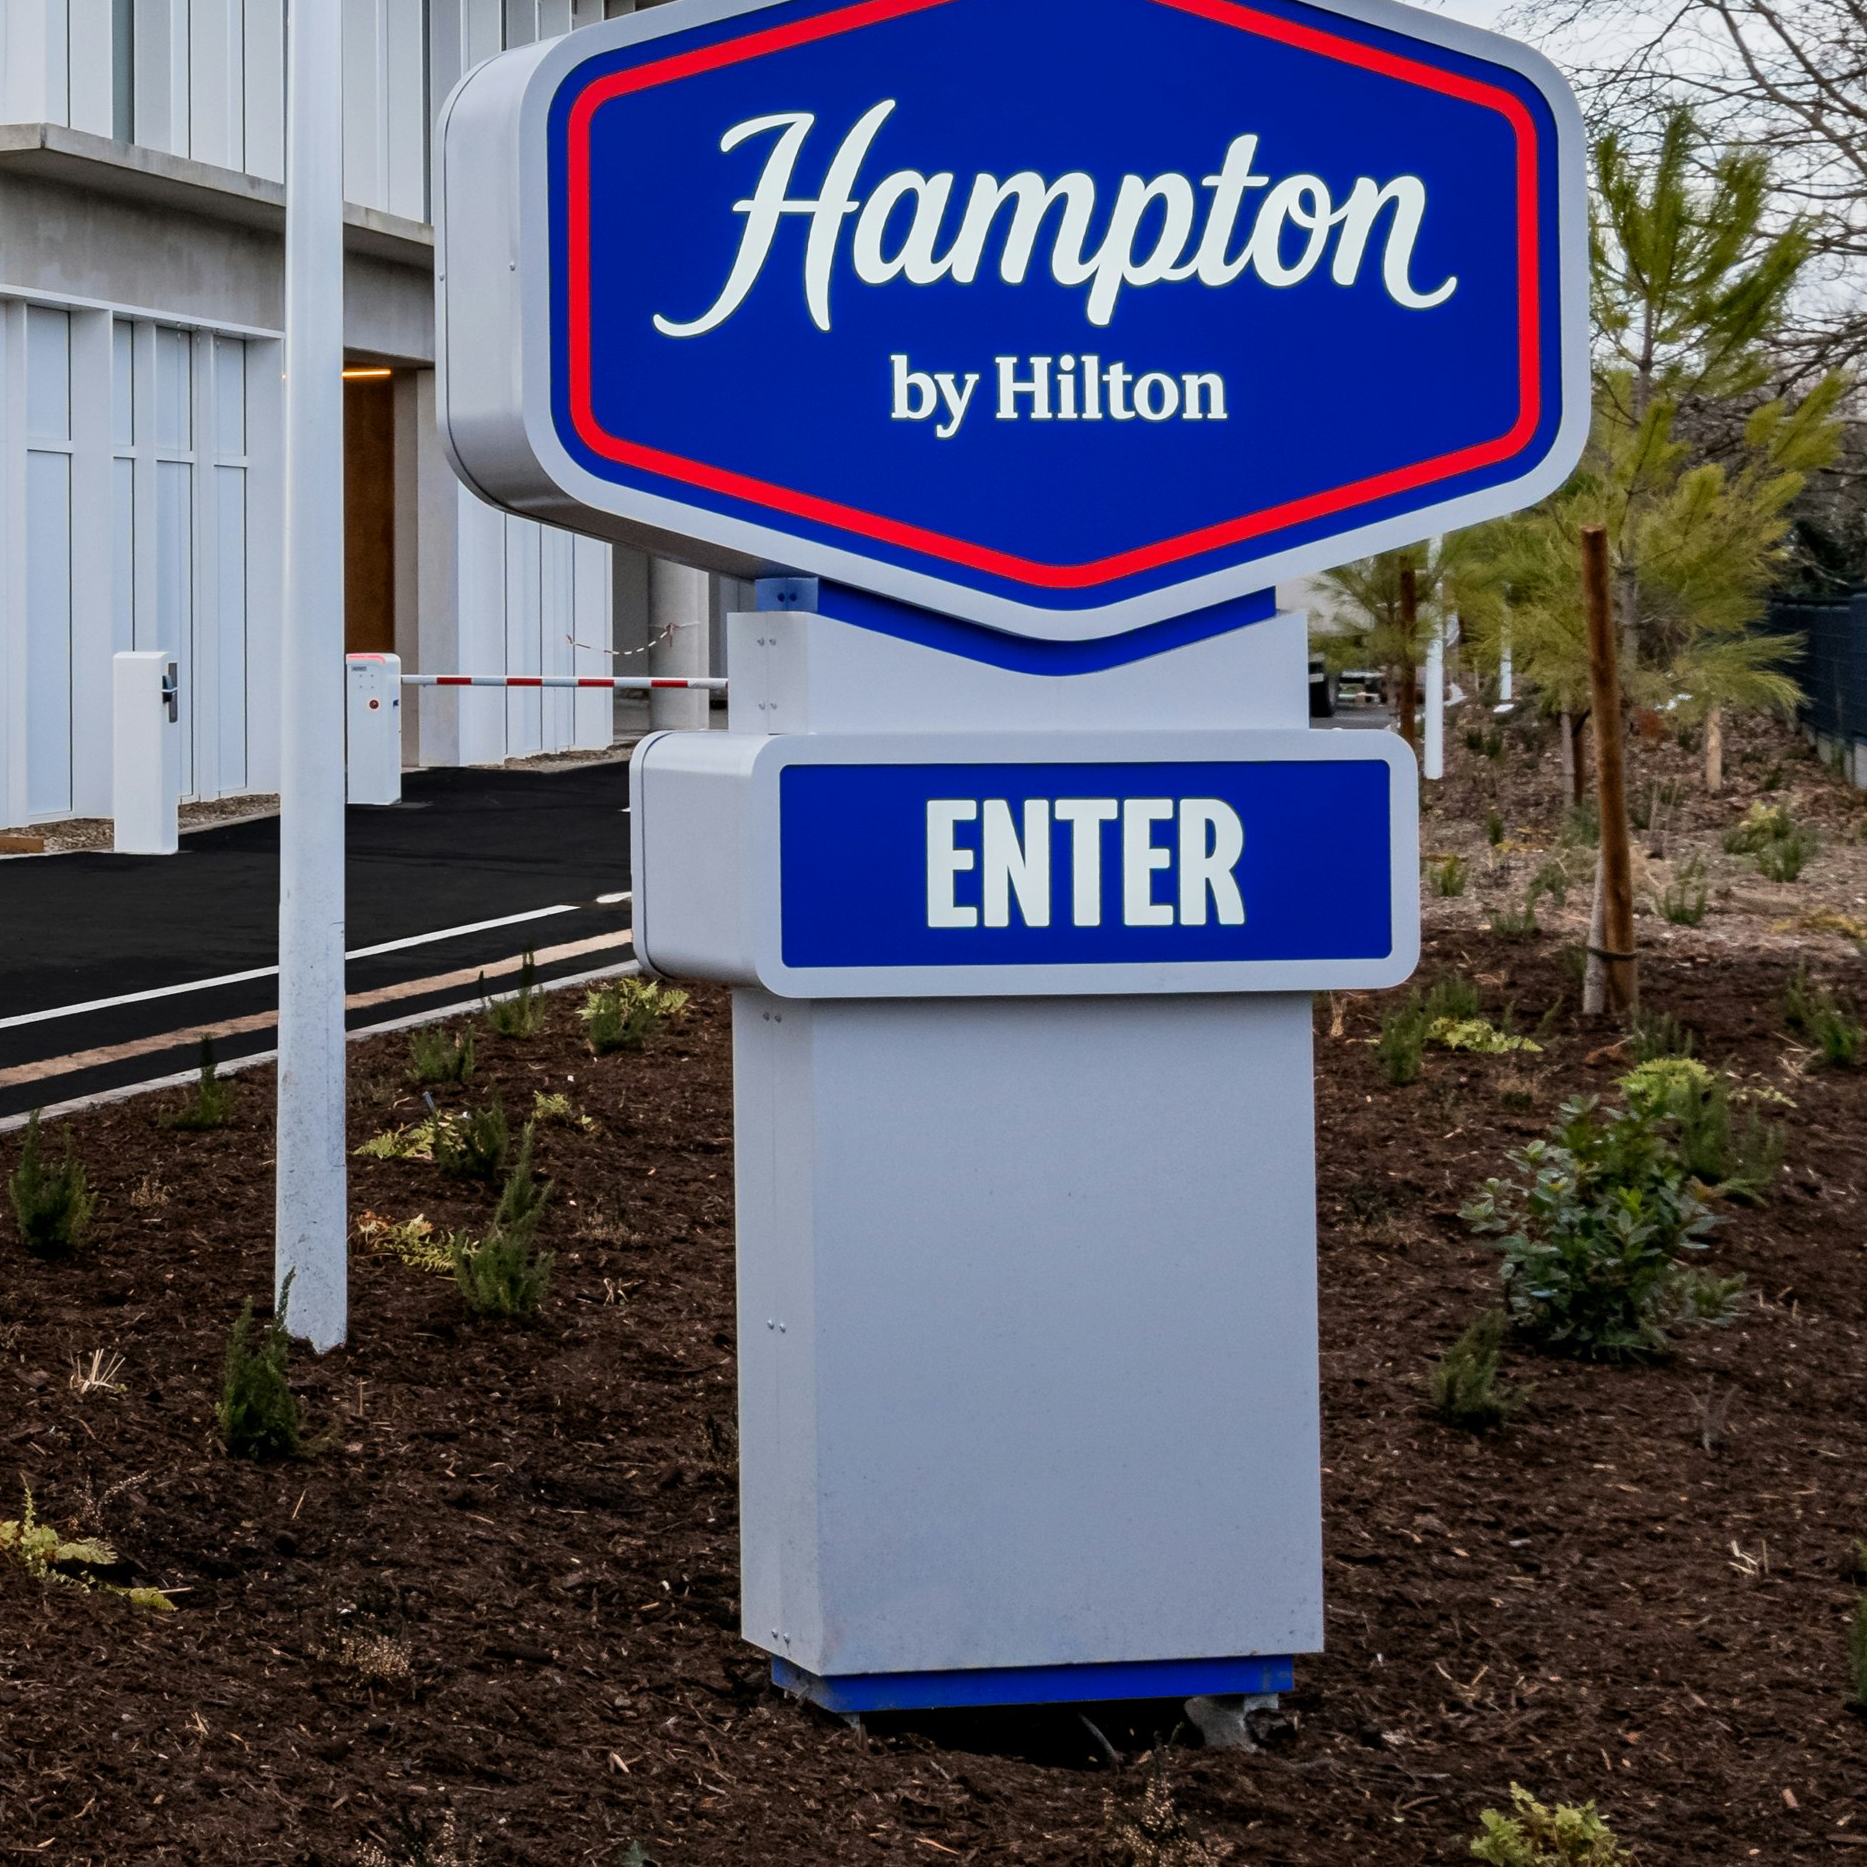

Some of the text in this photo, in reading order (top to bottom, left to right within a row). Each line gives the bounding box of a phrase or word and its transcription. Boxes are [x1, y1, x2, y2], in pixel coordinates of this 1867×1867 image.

[653, 99, 1457, 336] Hampton
[891, 355, 1227, 438] by Hilton
[927, 799, 1244, 927] ENTER
